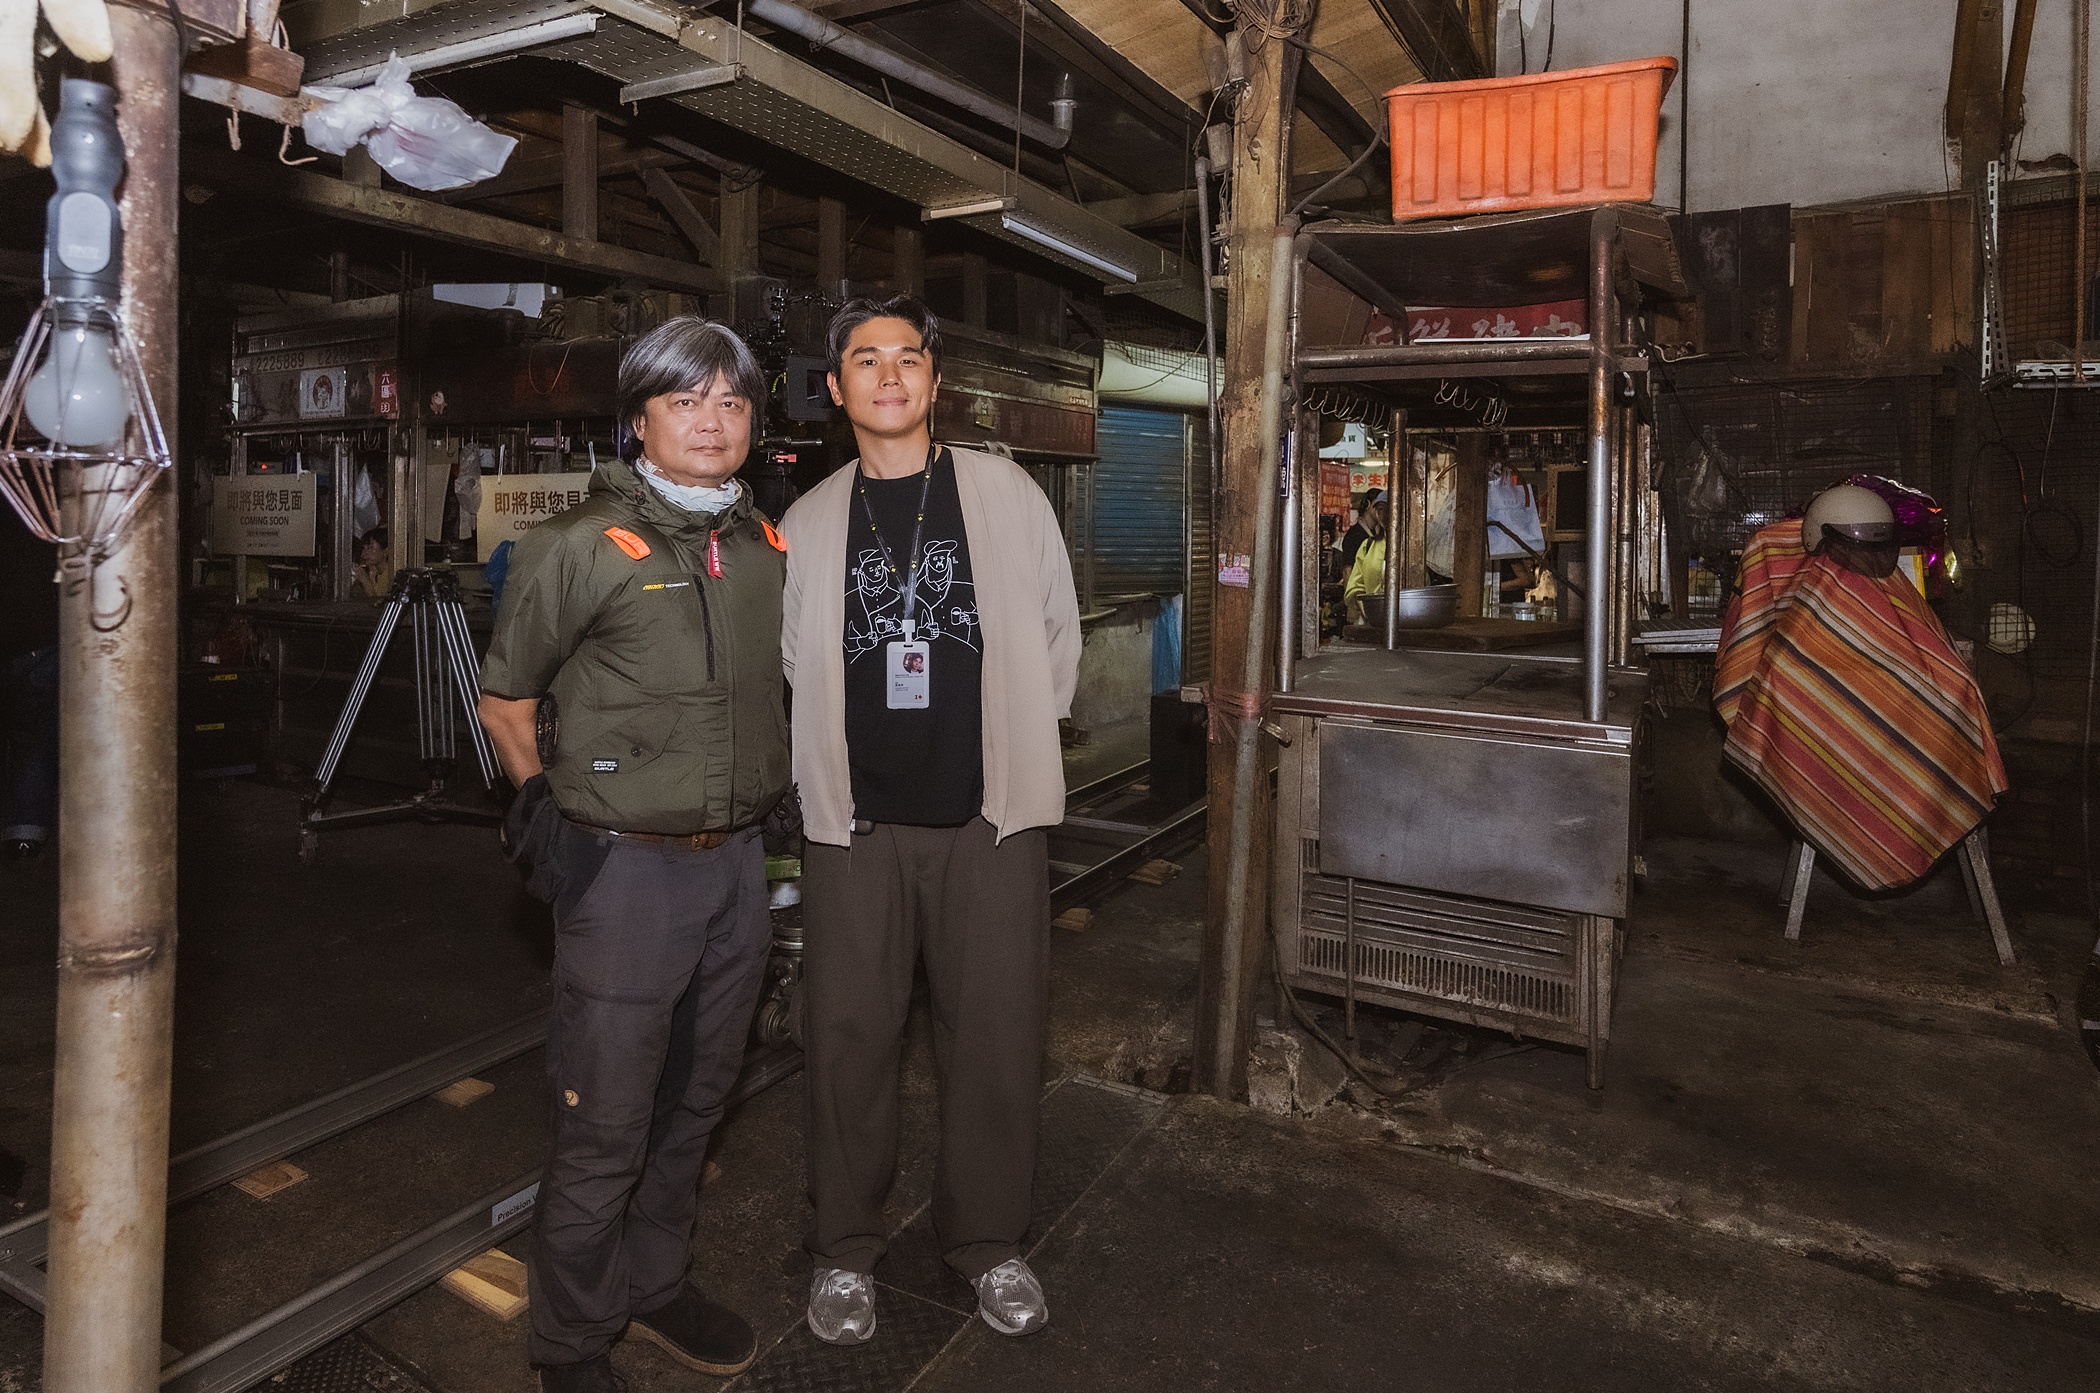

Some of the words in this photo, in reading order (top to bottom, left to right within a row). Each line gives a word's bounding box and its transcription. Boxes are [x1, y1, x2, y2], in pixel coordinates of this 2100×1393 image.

[1352, 473, 1388, 487] 李生
[227, 489, 303, 512] 即將與您見面
[240, 516, 268, 526] COMING
[269, 516, 289, 526] SOON
[497, 1198, 531, 1222] Precision
